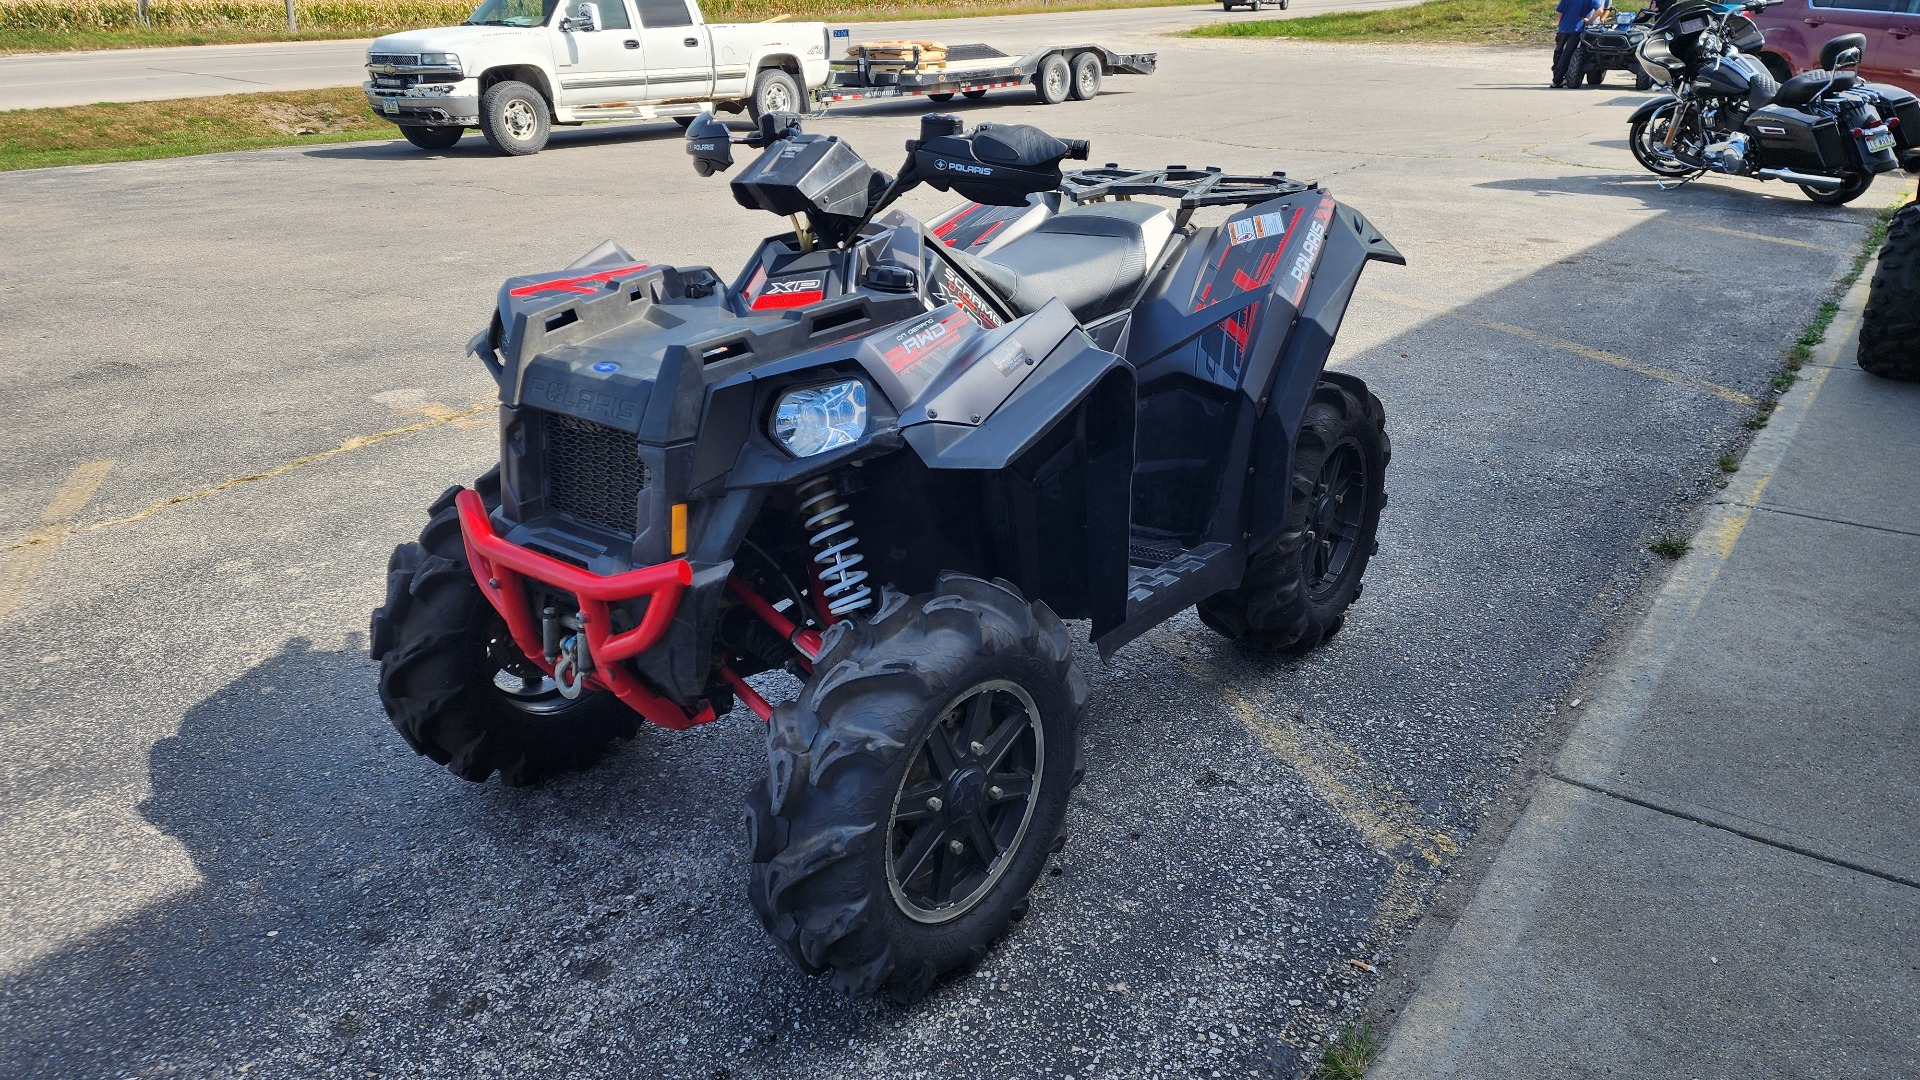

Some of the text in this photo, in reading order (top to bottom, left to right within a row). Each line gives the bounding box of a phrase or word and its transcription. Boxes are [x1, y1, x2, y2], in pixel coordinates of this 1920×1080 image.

[693, 143, 715, 151] POLARIS
[948, 162, 993, 176] POLARIS
[1290, 220, 1325, 283] POLARIS
[766, 280, 820, 294] XP
[901, 322, 946, 355] AWD
[529, 377, 638, 420] POLARIS
